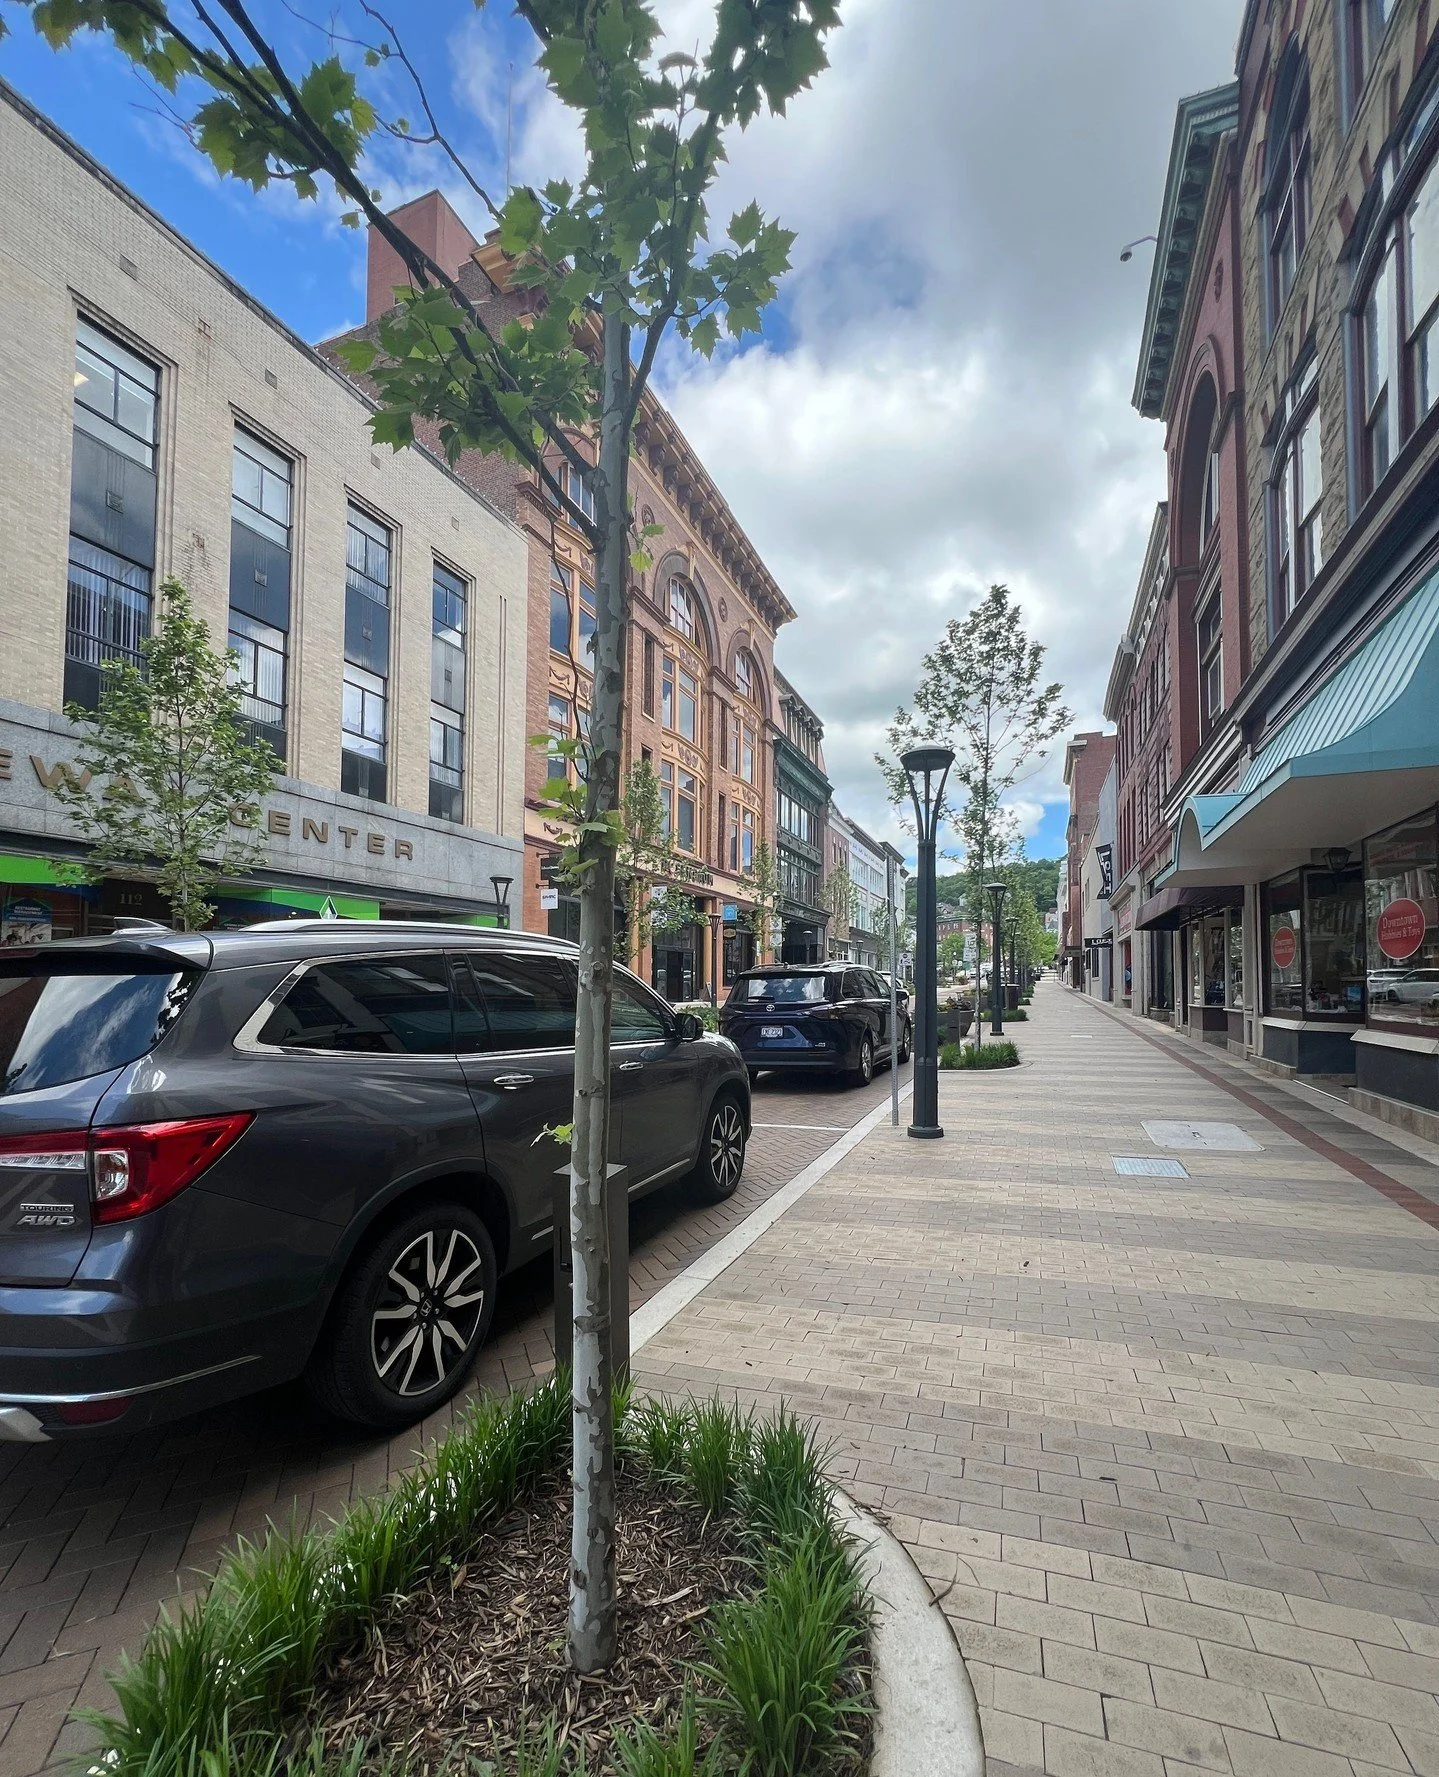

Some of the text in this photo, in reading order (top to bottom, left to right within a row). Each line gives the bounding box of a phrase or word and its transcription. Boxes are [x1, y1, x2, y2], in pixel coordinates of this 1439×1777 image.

[229, 802, 414, 861] CENTER
[1097, 850, 1112, 895] LOFT
[120, 893, 143, 905] 112
[1382, 914, 1418, 929] Downtown
[1381, 926, 1420, 940] Hobbies & Toys
[21, 1204, 74, 1212] TOURING
[17, 1215, 75, 1226] AWD
